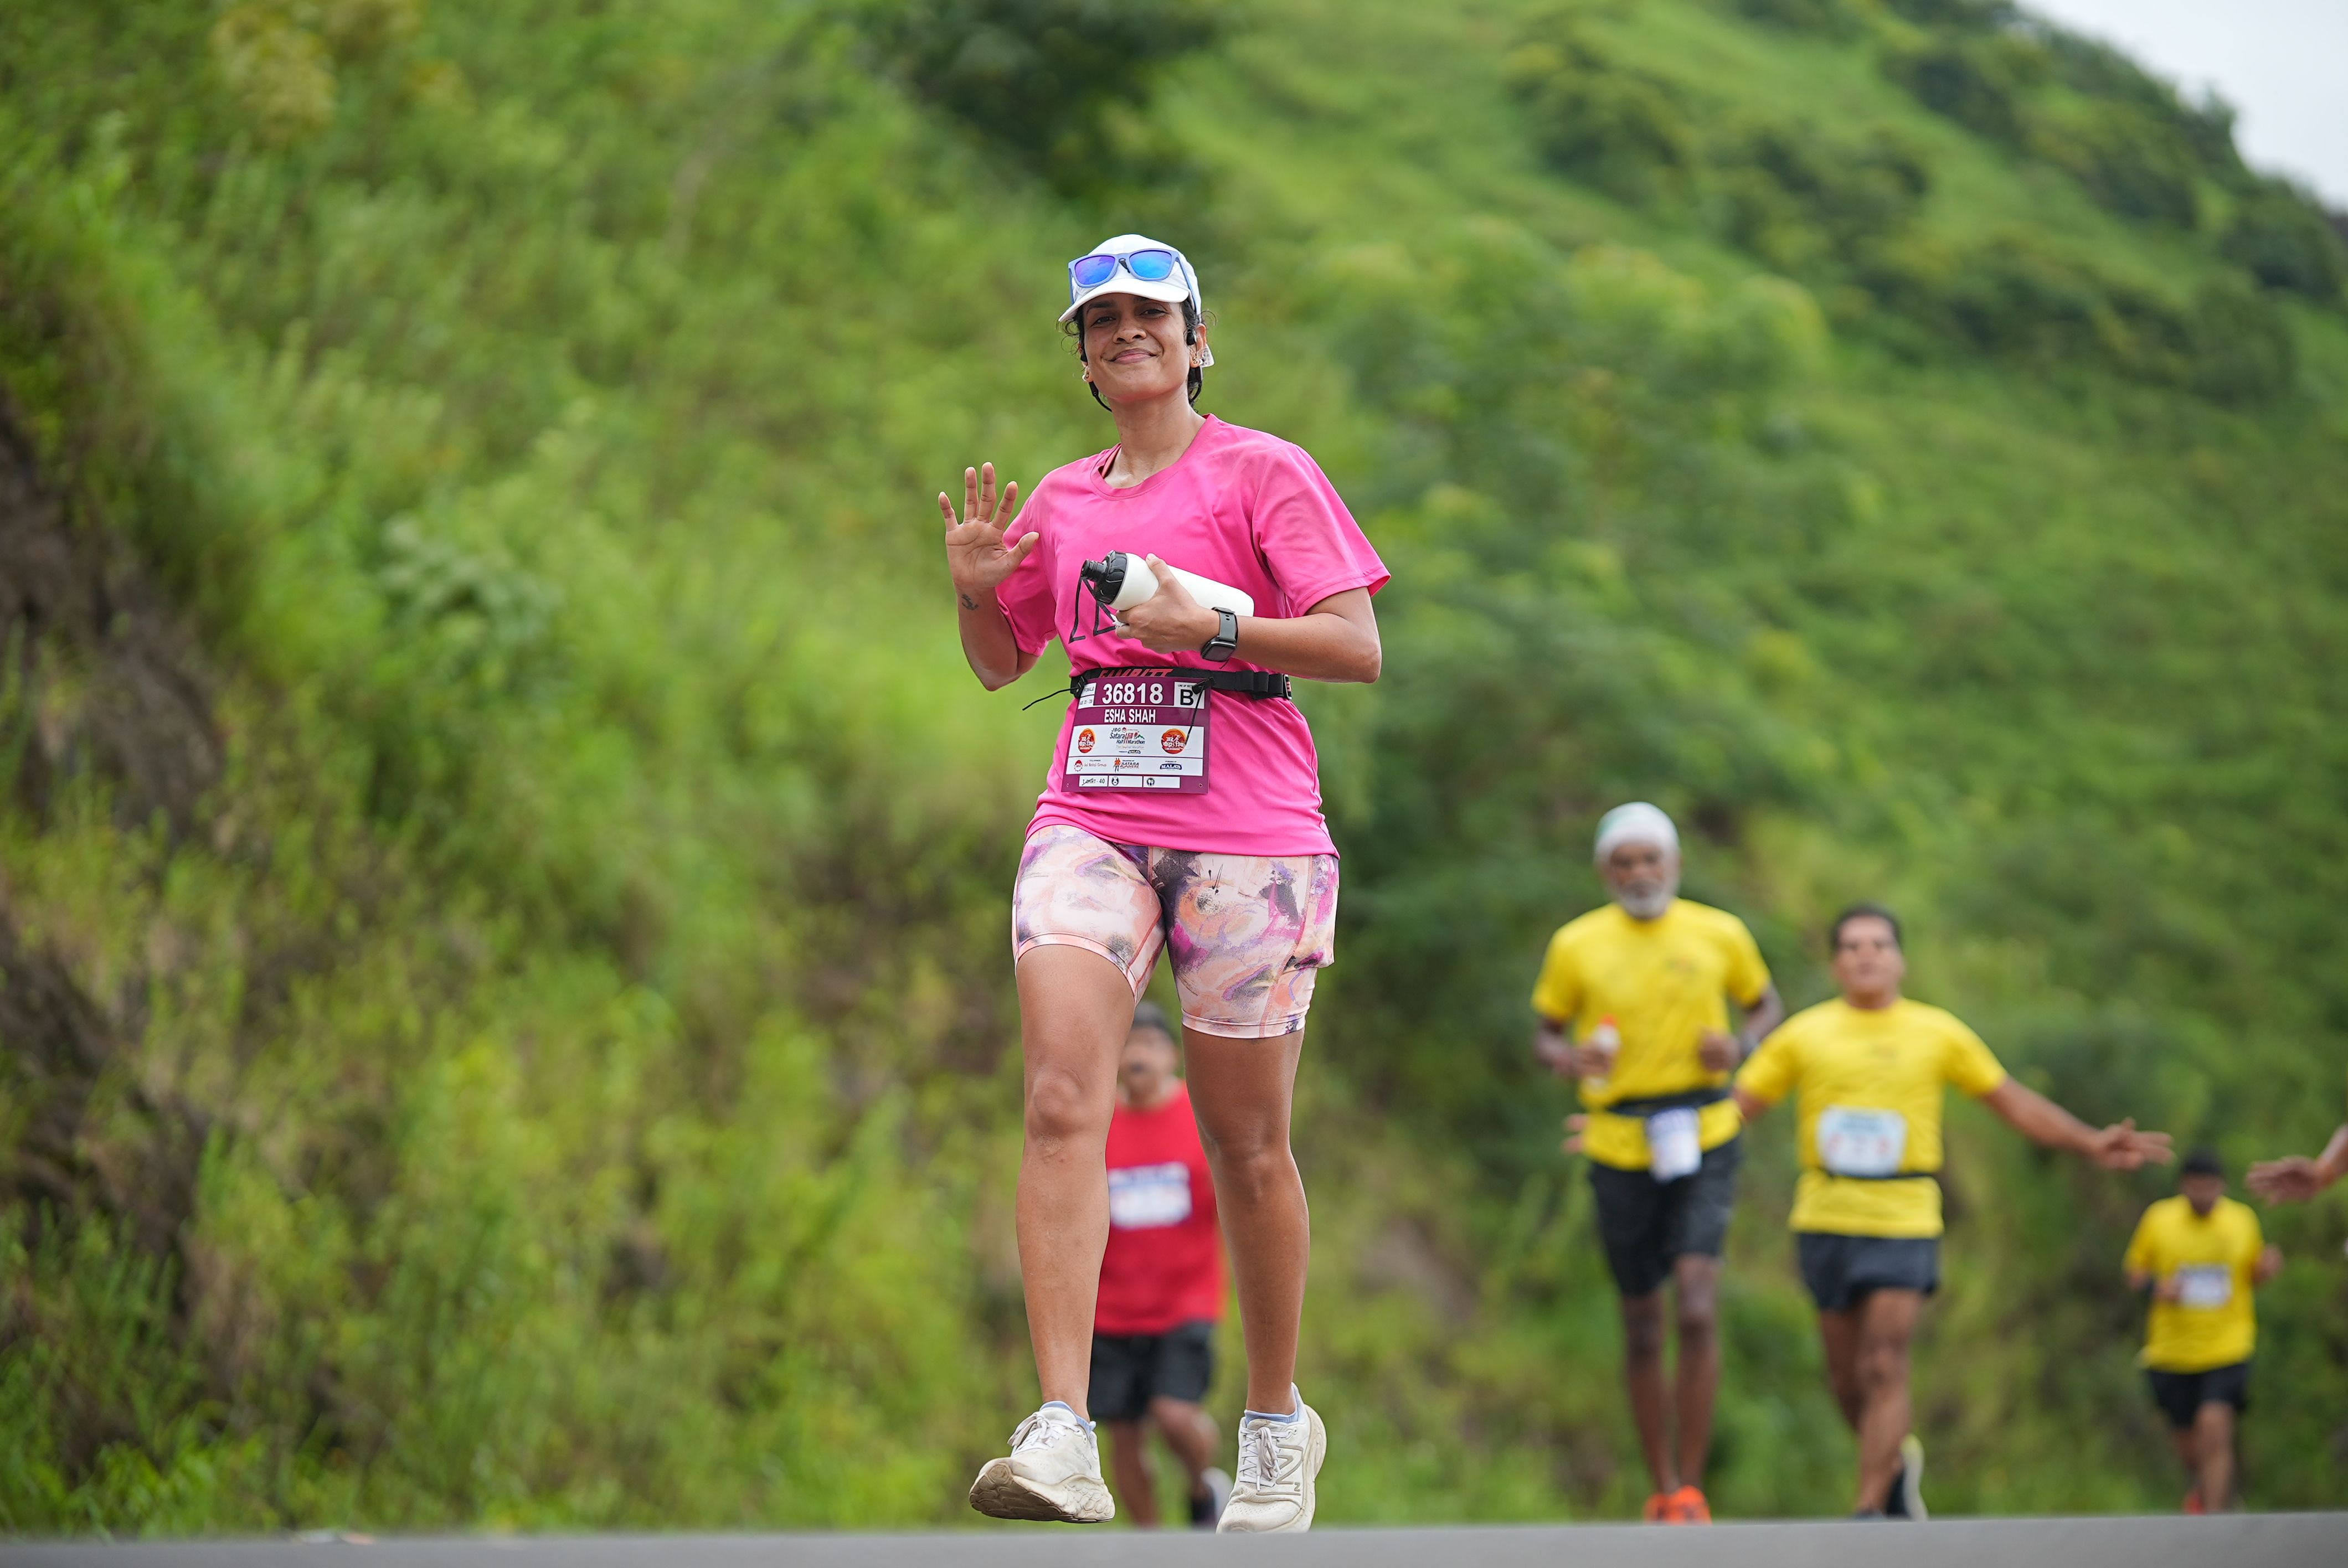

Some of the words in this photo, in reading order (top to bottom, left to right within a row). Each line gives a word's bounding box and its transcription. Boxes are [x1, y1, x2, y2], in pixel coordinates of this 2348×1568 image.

[1102, 683, 1163, 704] 36818
[1180, 689, 1194, 705] B
[1104, 708, 1126, 723] ESHA
[1128, 708, 1156, 723] SHAH
